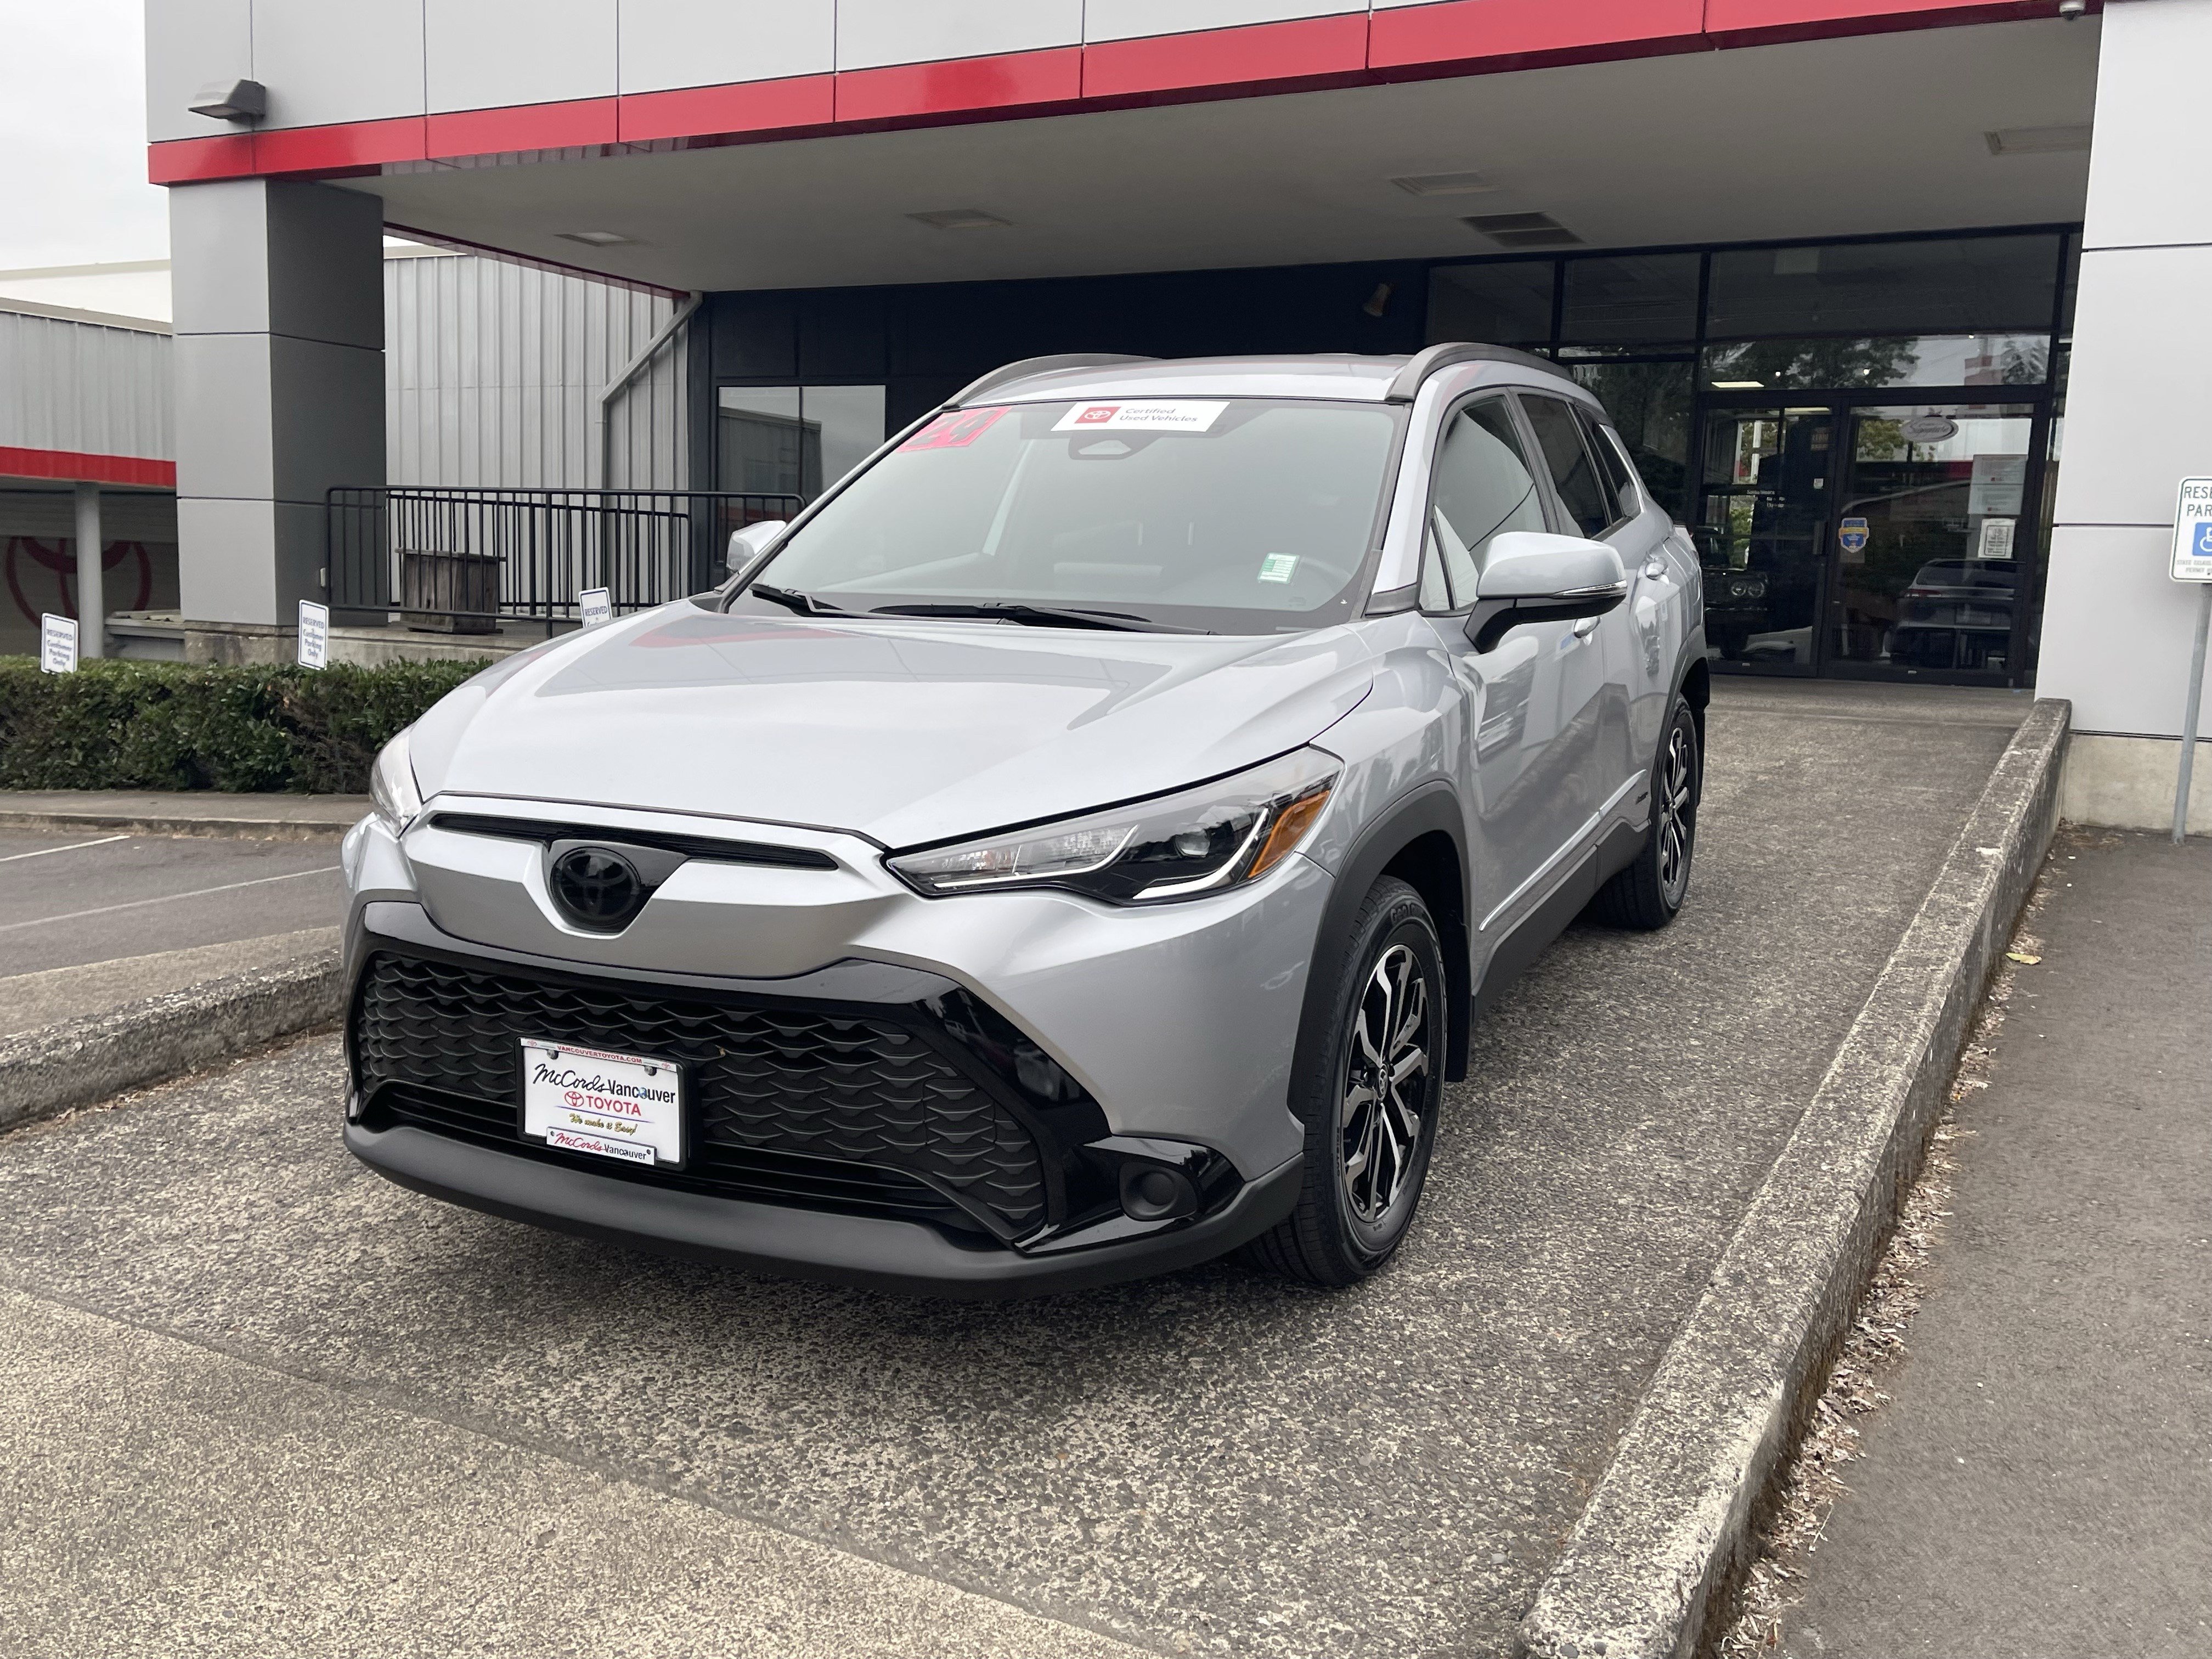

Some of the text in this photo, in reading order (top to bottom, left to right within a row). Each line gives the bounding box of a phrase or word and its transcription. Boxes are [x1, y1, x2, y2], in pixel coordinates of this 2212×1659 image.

[584, 606, 608, 617] RESERVED
[303, 617, 325, 629] RESERVED
[557, 1045, 643, 1064] VANCOUVERTOYOTA.COM
[586, 1095, 642, 1116] TOYOTA
[569, 1113, 583, 1124] We
[584, 1118, 605, 1128] make
